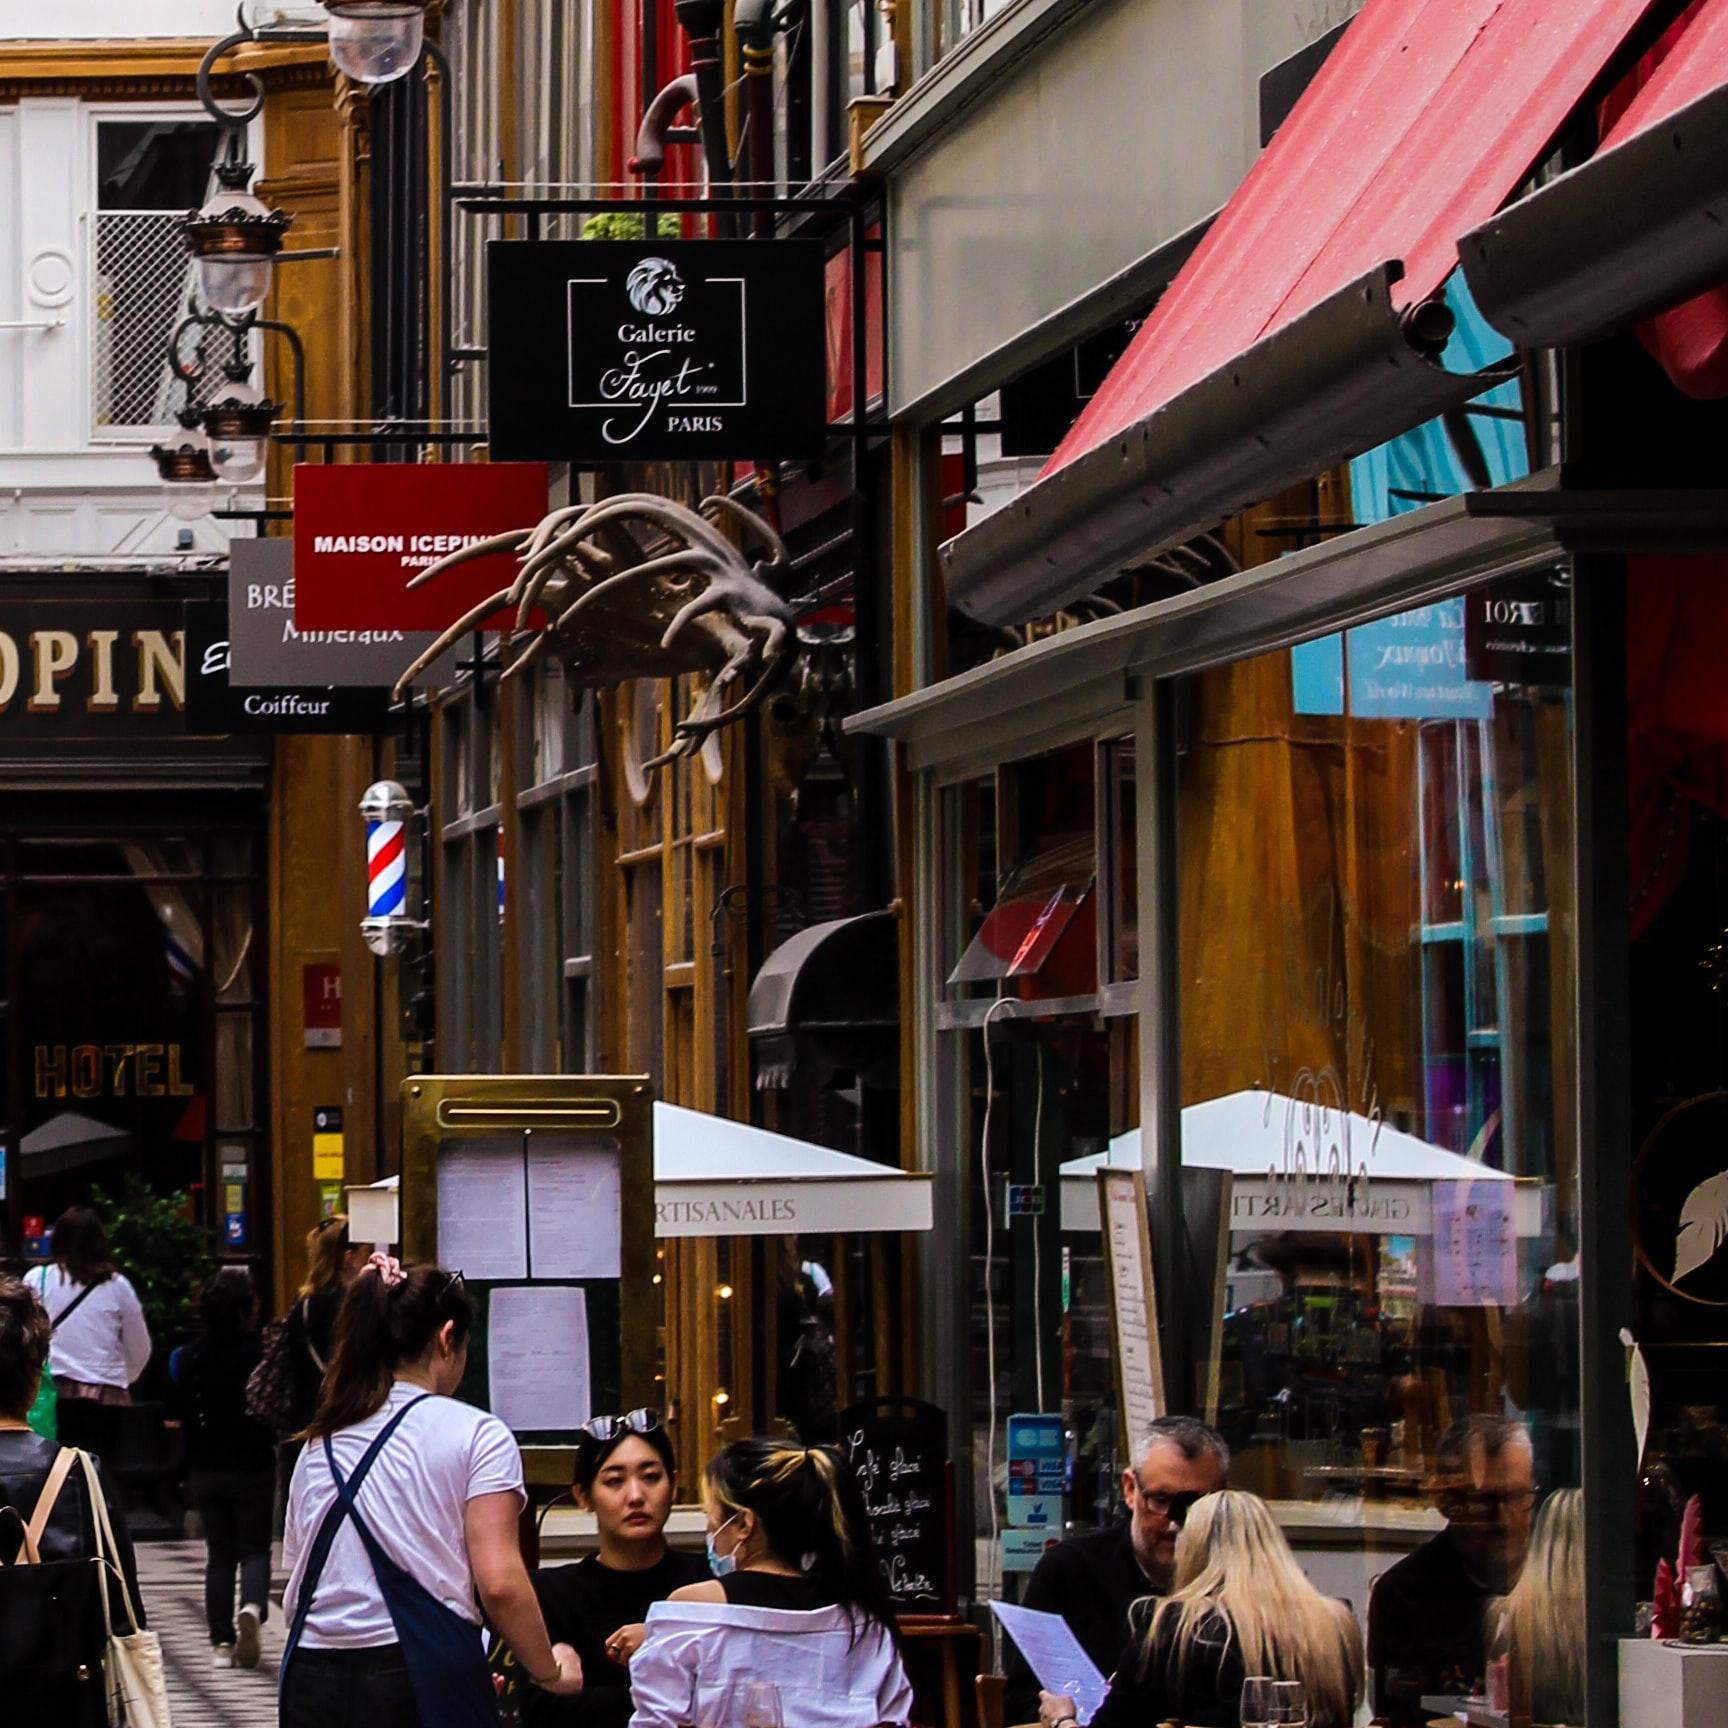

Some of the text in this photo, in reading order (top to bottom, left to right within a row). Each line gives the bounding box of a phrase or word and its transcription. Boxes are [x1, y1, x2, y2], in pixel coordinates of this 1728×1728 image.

[618, 323, 696, 343] Galerie
[599, 350, 704, 445] Fayet
[668, 417, 723, 432] PARIS
[314, 535, 494, 553] MAISON ICEPIN
[400, 555, 443, 568] PARIS
[247, 578, 295, 610] BRÉ
[244, 694, 331, 715] Coiffeur
[34, 1043, 194, 1098] HOTEL
[655, 1198, 797, 1223] RTISANALES
